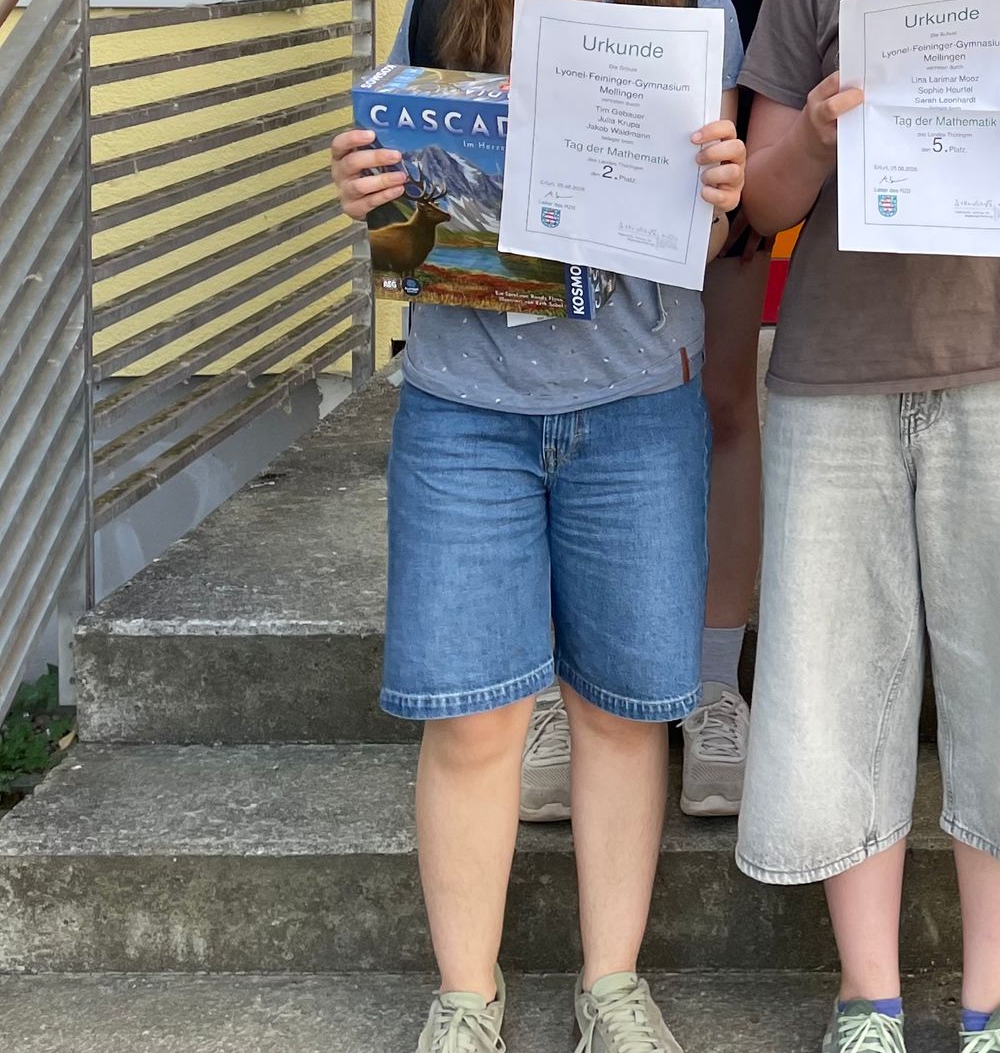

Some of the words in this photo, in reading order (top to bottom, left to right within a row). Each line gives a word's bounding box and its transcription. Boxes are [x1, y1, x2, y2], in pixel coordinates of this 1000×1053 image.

[904, 6, 980, 29] Urkunde
[582, 35, 664, 59] Urkunde
[923, 53, 966, 63] Mellingen
[555, 66, 690, 92] Lyonel-Feininger-Gymnasium
[599, 85, 644, 100] Mellingen
[893, 115, 912, 127] Tag
[915, 115, 933, 126] der
[935, 116, 997, 127] Mathematik
[478, 142, 505, 151] Herze
[564, 139, 584, 152] Tag
[586, 143, 604, 154] der
[607, 146, 670, 166] Mathematik
[570, 265, 585, 315] KOSMO
